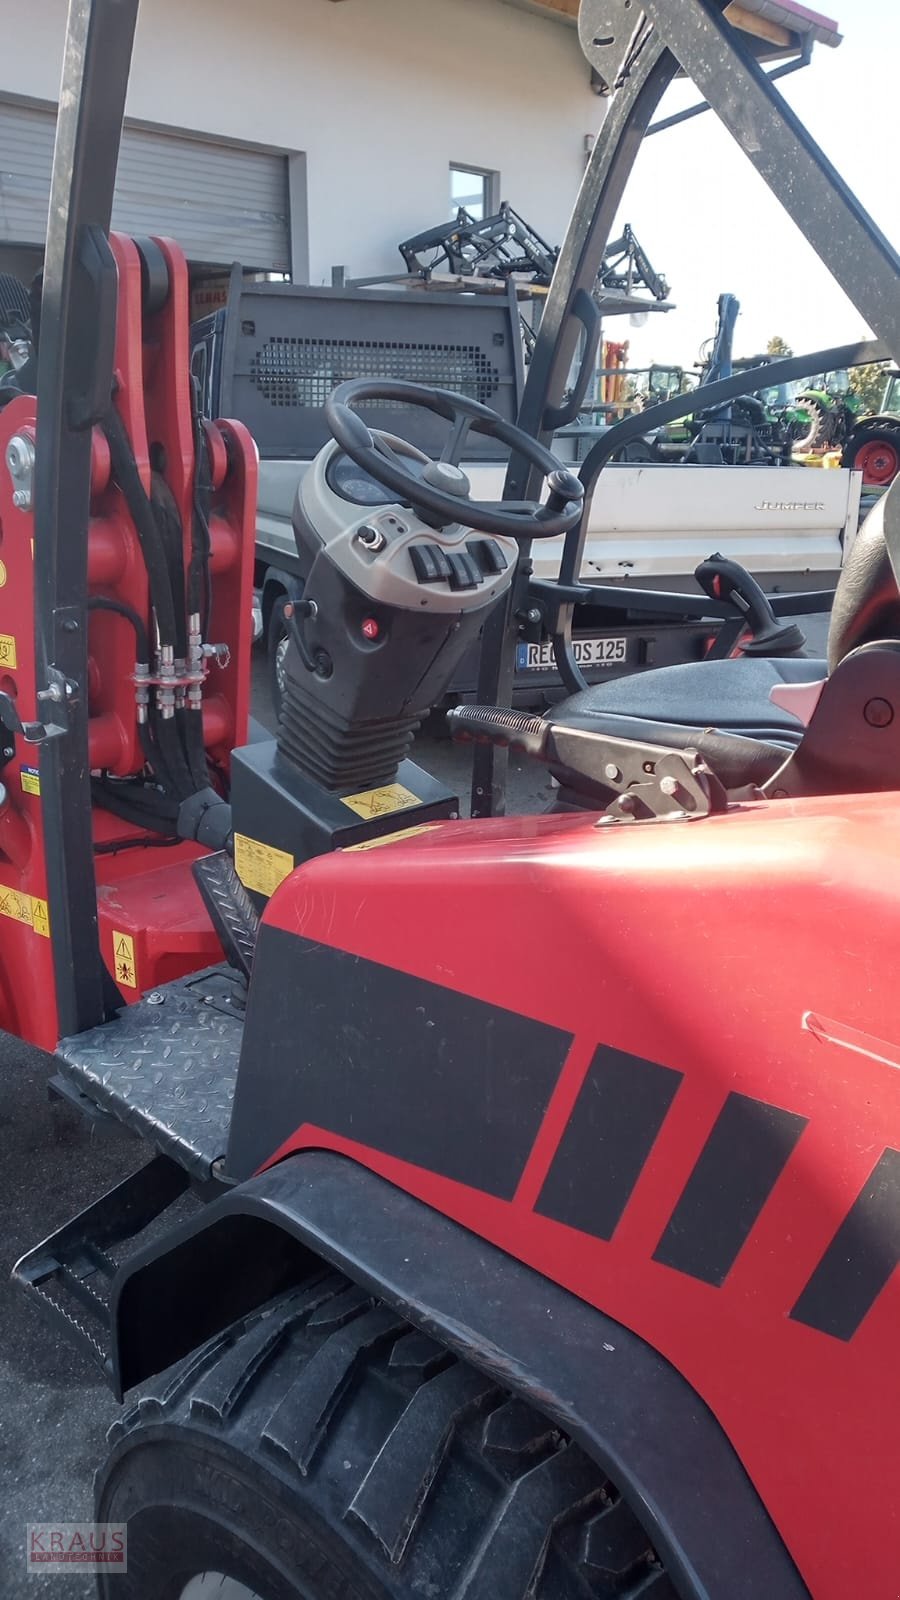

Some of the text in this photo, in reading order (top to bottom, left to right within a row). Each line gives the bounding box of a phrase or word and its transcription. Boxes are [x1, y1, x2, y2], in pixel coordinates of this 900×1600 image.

[753, 500, 825, 511] JUMPER
[573, 642, 593, 662] DS
[595, 641, 625, 661] 125
